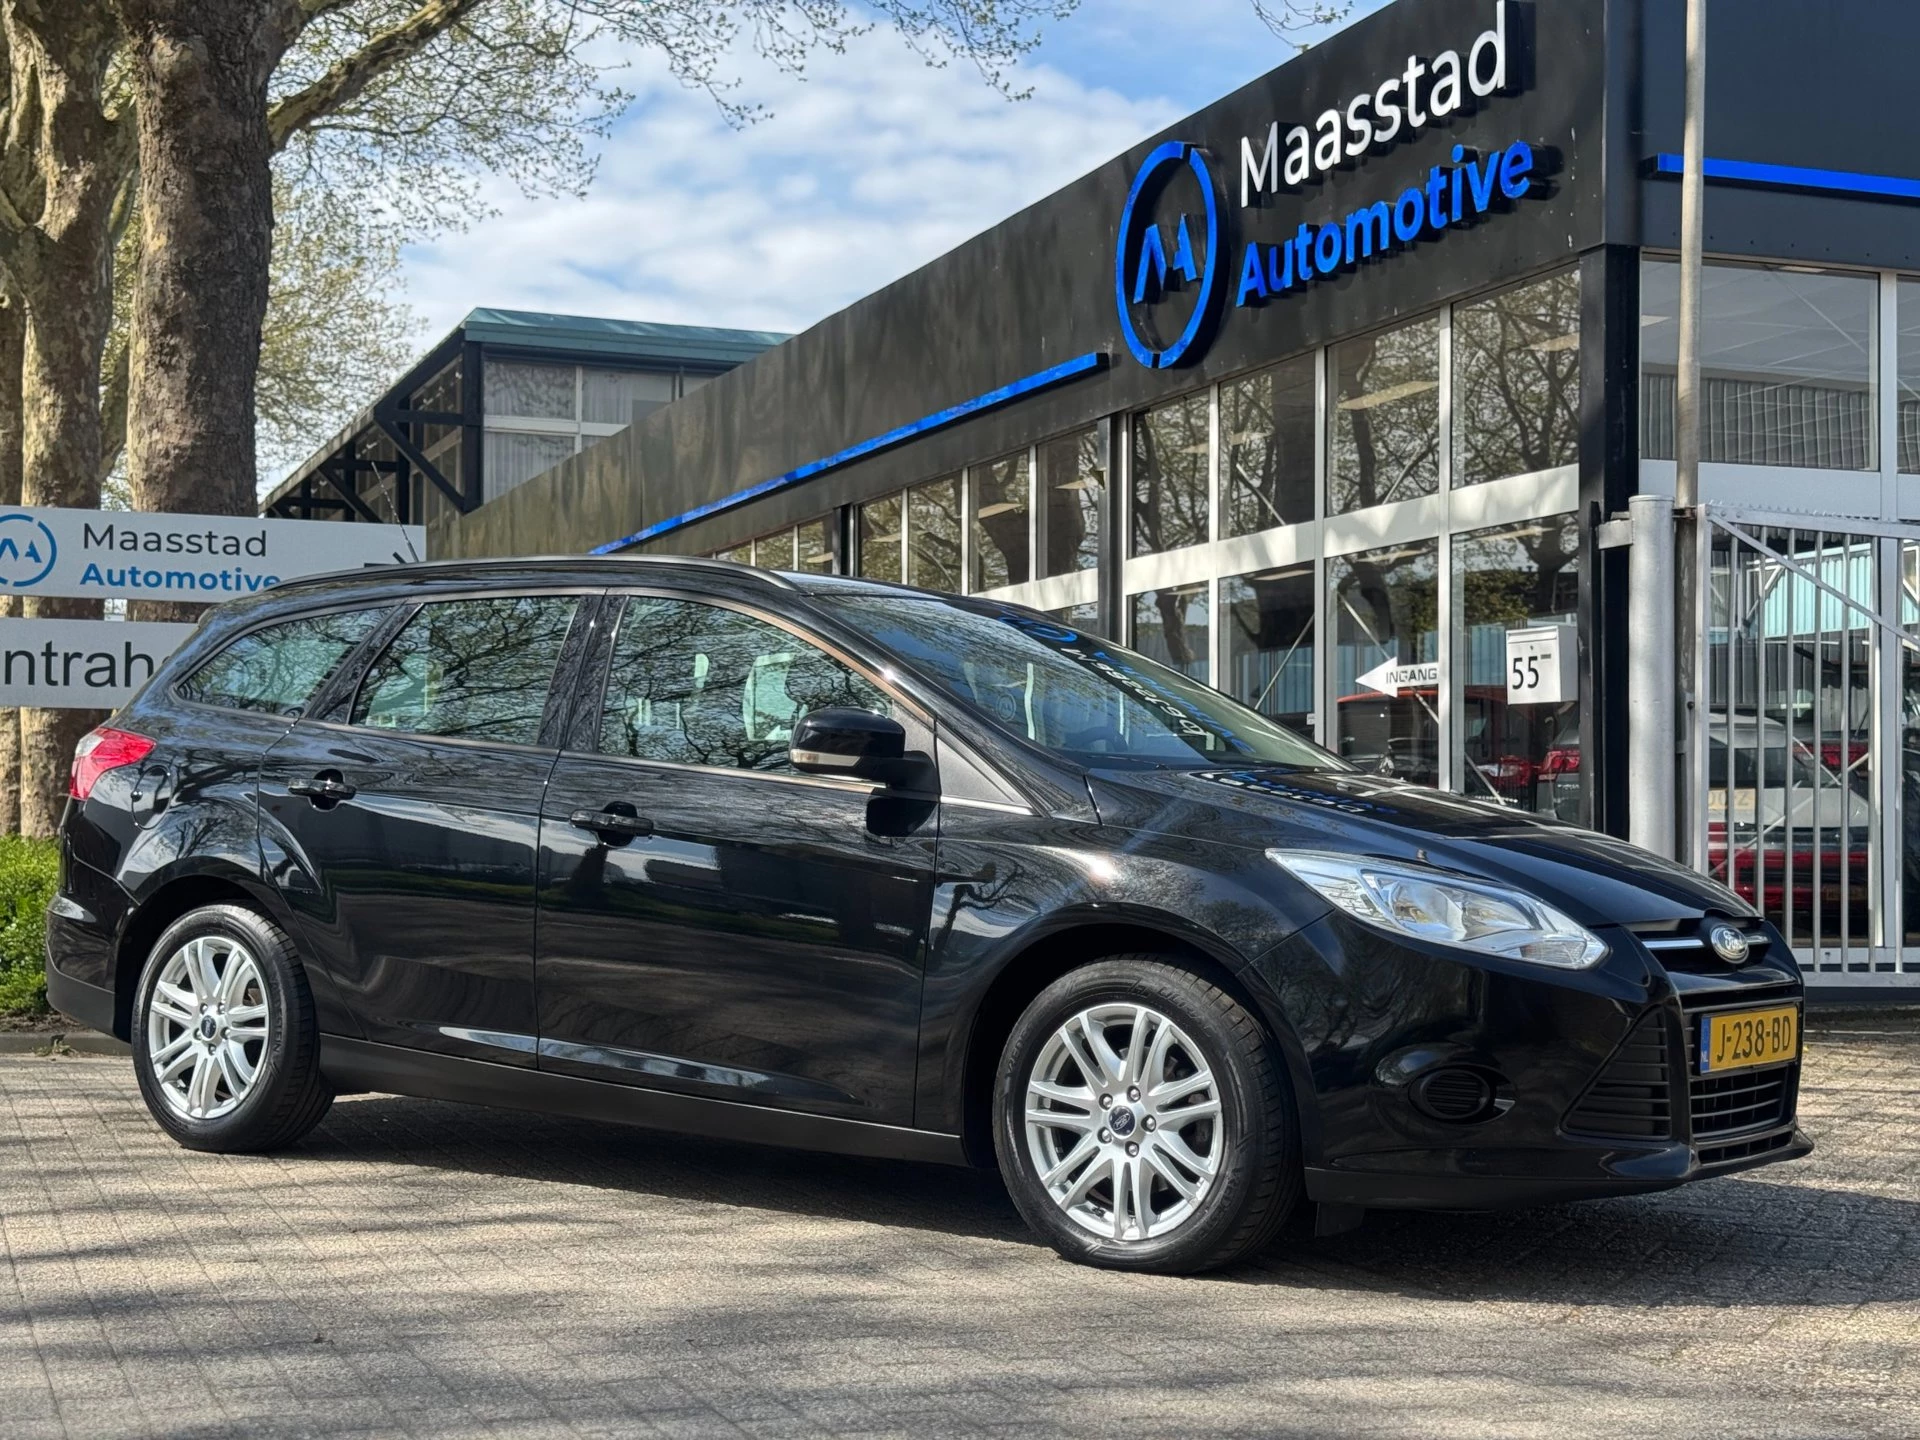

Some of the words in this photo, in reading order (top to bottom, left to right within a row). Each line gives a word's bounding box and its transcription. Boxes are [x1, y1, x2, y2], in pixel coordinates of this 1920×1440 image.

[1241, 0, 1506, 208] Maasstad
[1236, 139, 1533, 307] Automotive
[83, 522, 267, 557] Maasstad
[80, 562, 281, 592] Automotive
[1385, 668, 1438, 684] INGANG
[1512, 655, 1539, 690] 55
[1717, 1015, 1791, 1063] J-238-BD
